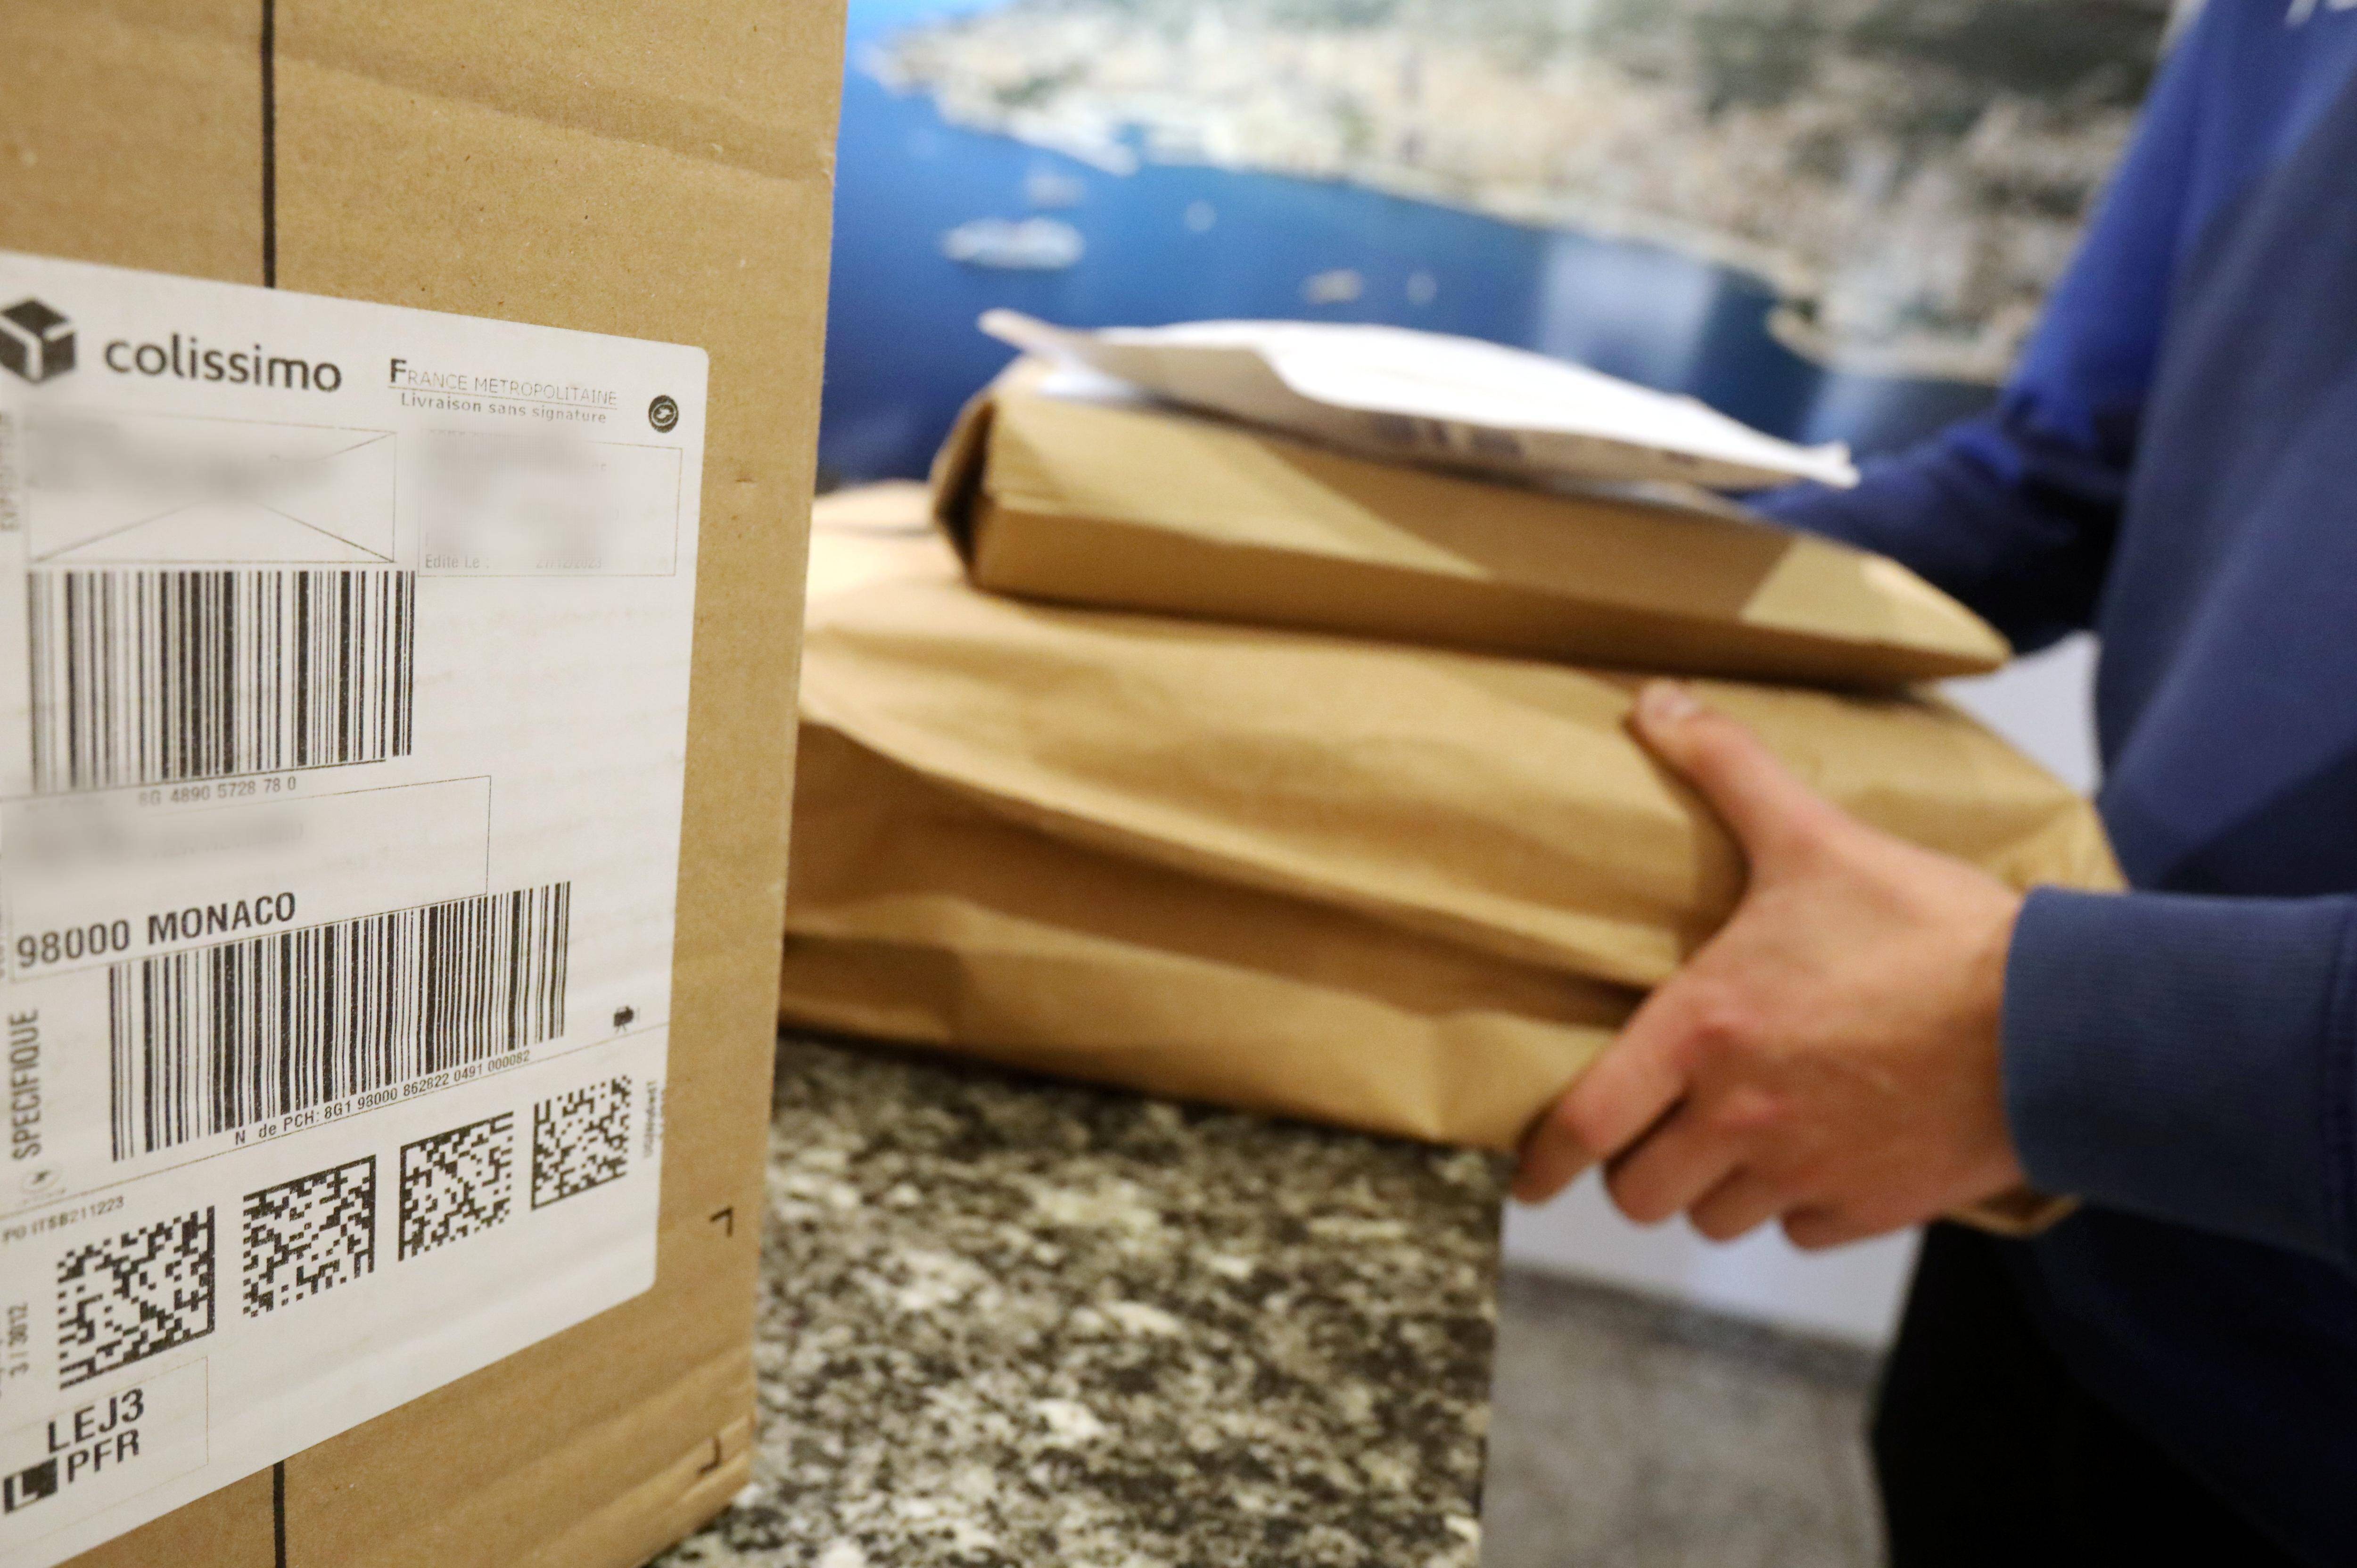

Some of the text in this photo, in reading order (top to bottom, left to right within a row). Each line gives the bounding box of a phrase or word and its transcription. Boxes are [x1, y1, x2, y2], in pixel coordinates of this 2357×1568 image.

[104, 332, 342, 392] colissimo
[390, 358, 617, 405] FRANCE METROPOLITAINE
[401, 392, 607, 423] Livraison sans signature
[217, 780, 256, 799] 5728
[264, 777, 280, 793] 78
[16, 919, 131, 969] 98000
[147, 891, 297, 946] MONACO
[9, 1008, 42, 1162] SPECIFIQUE
[259, 1124, 277, 1138] de
[283, 1111, 320, 1131] PCH:
[324, 1100, 351, 1119] 8G1
[403, 1073, 449, 1097] 862822
[453, 1063, 482, 1082] 0491
[487, 1049, 531, 1073] 000082
[48, 1387, 144, 1453] LEJ3
[67, 1429, 140, 1483] PFR
